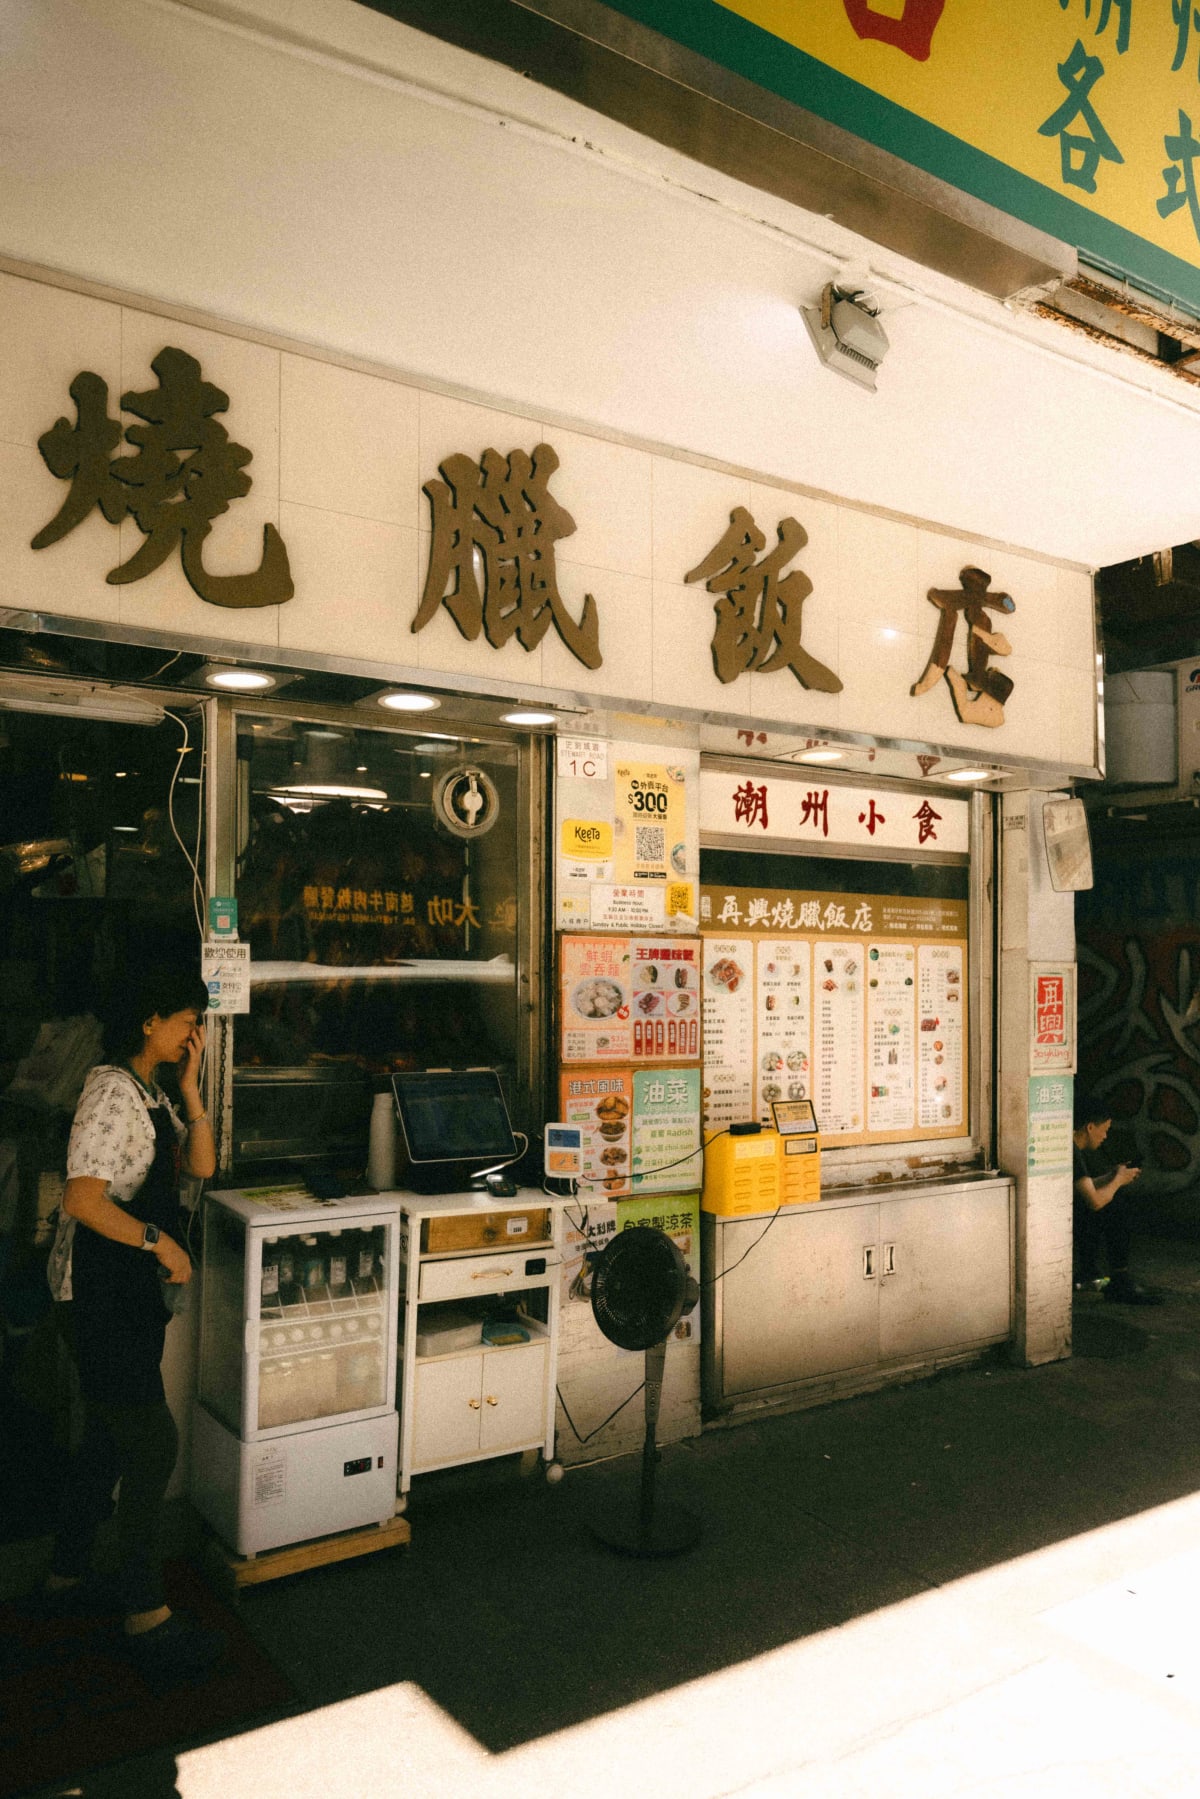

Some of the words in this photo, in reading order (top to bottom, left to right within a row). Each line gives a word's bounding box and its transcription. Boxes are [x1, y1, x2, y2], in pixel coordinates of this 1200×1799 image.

[30, 346, 1017, 729] 燒臘飯店
[1185, 684, 1200, 693] GR
[628, 791, 668, 813] $300
[732, 780, 942, 844] 潮州小食
[717, 894, 874, 932] 再興燒臘飯店
[1037, 980, 1064, 1042] 再興
[569, 1078, 624, 1096] 港式風味
[643, 1079, 689, 1104] 油菜
[1035, 1084, 1065, 1104] 油菜
[666, 1127, 693, 1137] Radish
